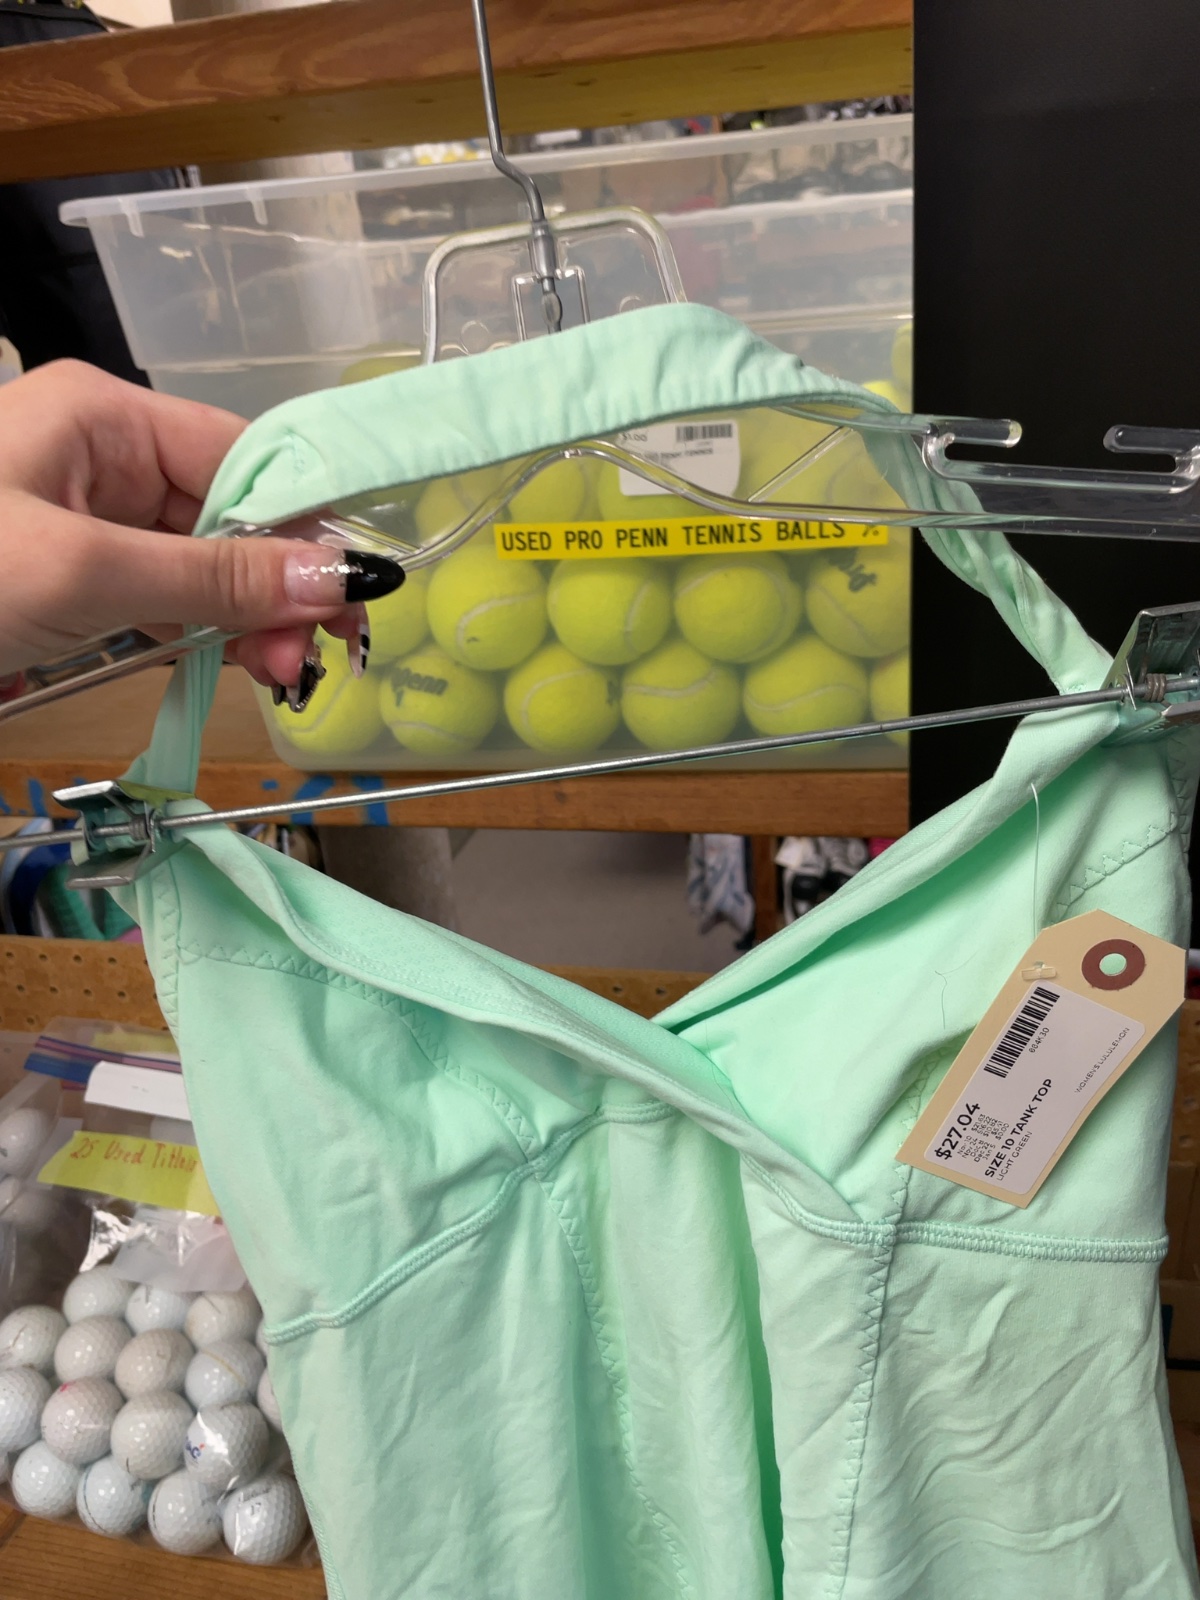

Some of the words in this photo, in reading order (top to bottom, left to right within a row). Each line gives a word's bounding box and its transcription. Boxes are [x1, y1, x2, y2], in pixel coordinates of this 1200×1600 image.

[501, 530, 553, 553] USED
[564, 528, 604, 551] PRO
[615, 526, 669, 549] PENN
[682, 521, 764, 547] TENNIS
[776, 520, 848, 542] BALLS
[1098, 1027, 1131, 1065] LULULEMON
[934, 1102, 981, 1160] $27.04
[984, 1151, 1007, 1178] SIZE
[1001, 1138, 1015, 1151] 10
[1010, 1103, 1038, 1136] TANK
[1032, 1078, 1053, 1105] TOP
[995, 1123, 1010, 1140] $0.00
[104, 1140, 147, 1165] Used
[996, 1158, 1015, 1181] LIGHT
[1011, 1131, 1033, 1158] GREEN
